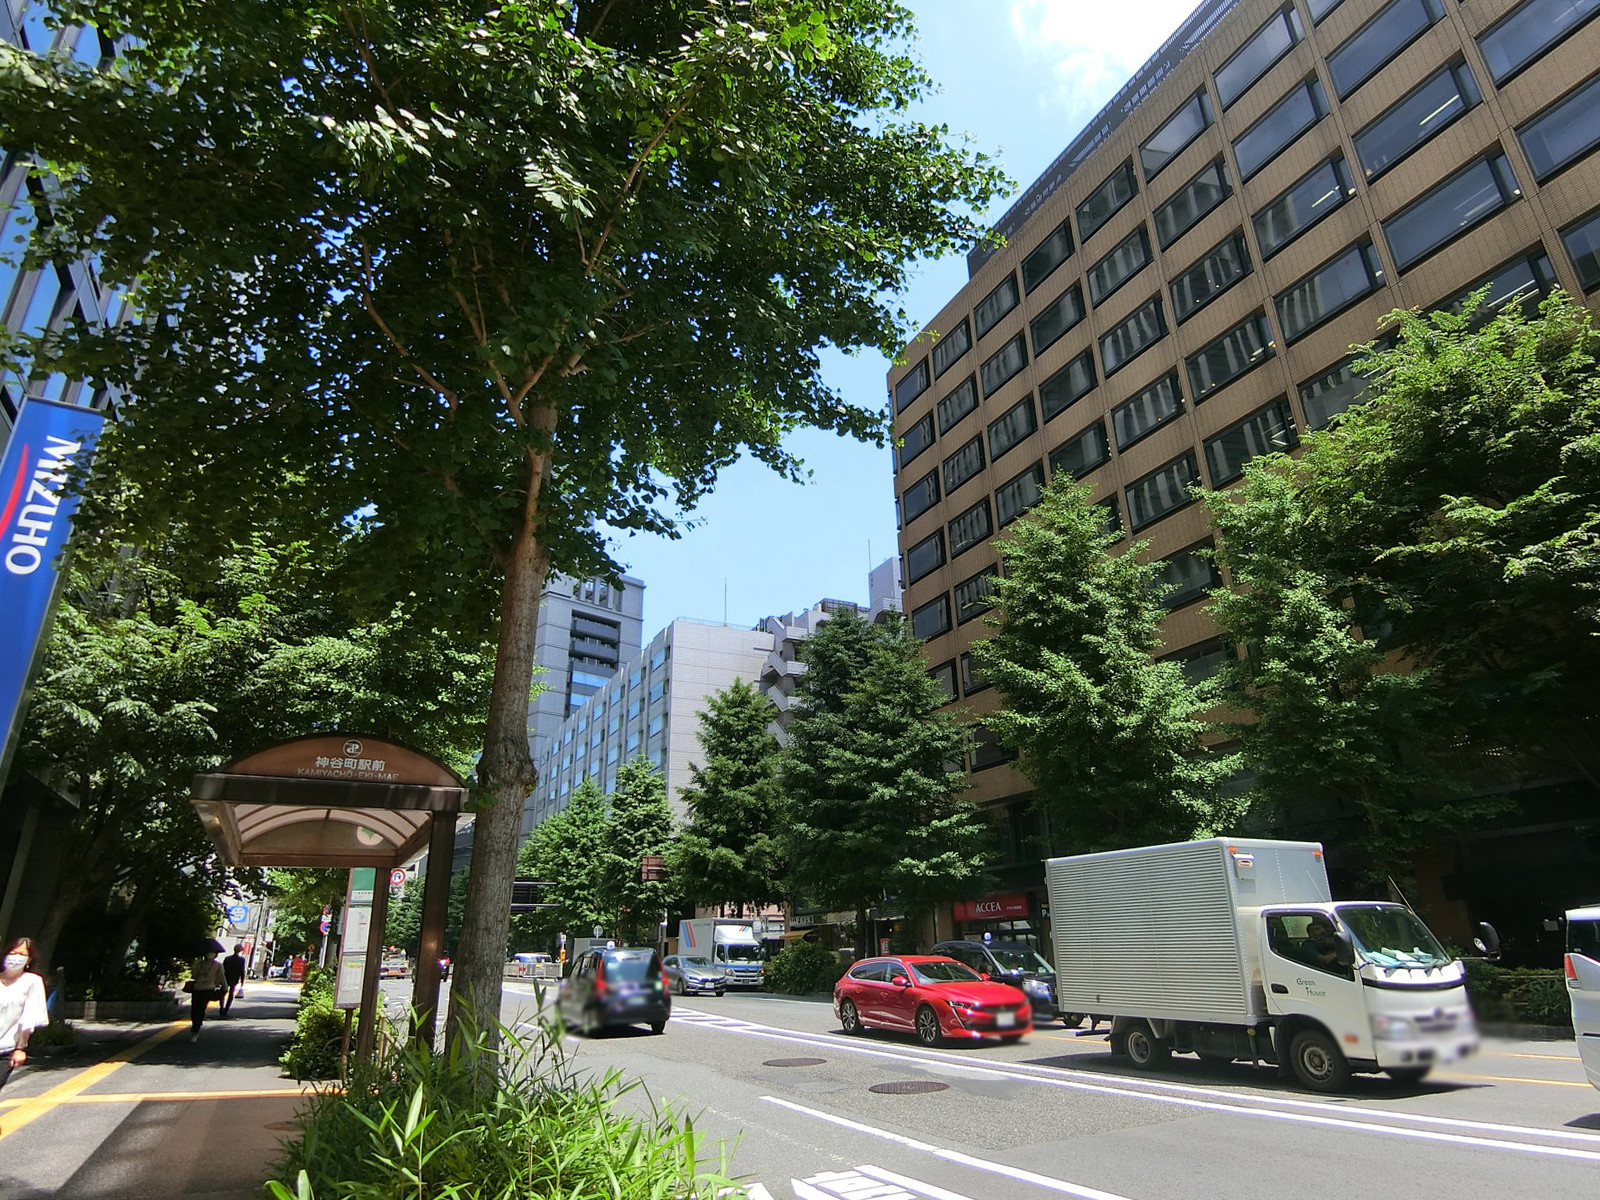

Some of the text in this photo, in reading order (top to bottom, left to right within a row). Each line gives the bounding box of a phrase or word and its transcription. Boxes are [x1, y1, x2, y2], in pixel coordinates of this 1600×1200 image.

[5, 435, 82, 575] MIZUHO
[315, 756, 386, 771] 神谷町駅前
[975, 902, 1002, 913] ACCEA
[1296, 978, 1316, 986] Green
[1305, 986, 1326, 997] House
